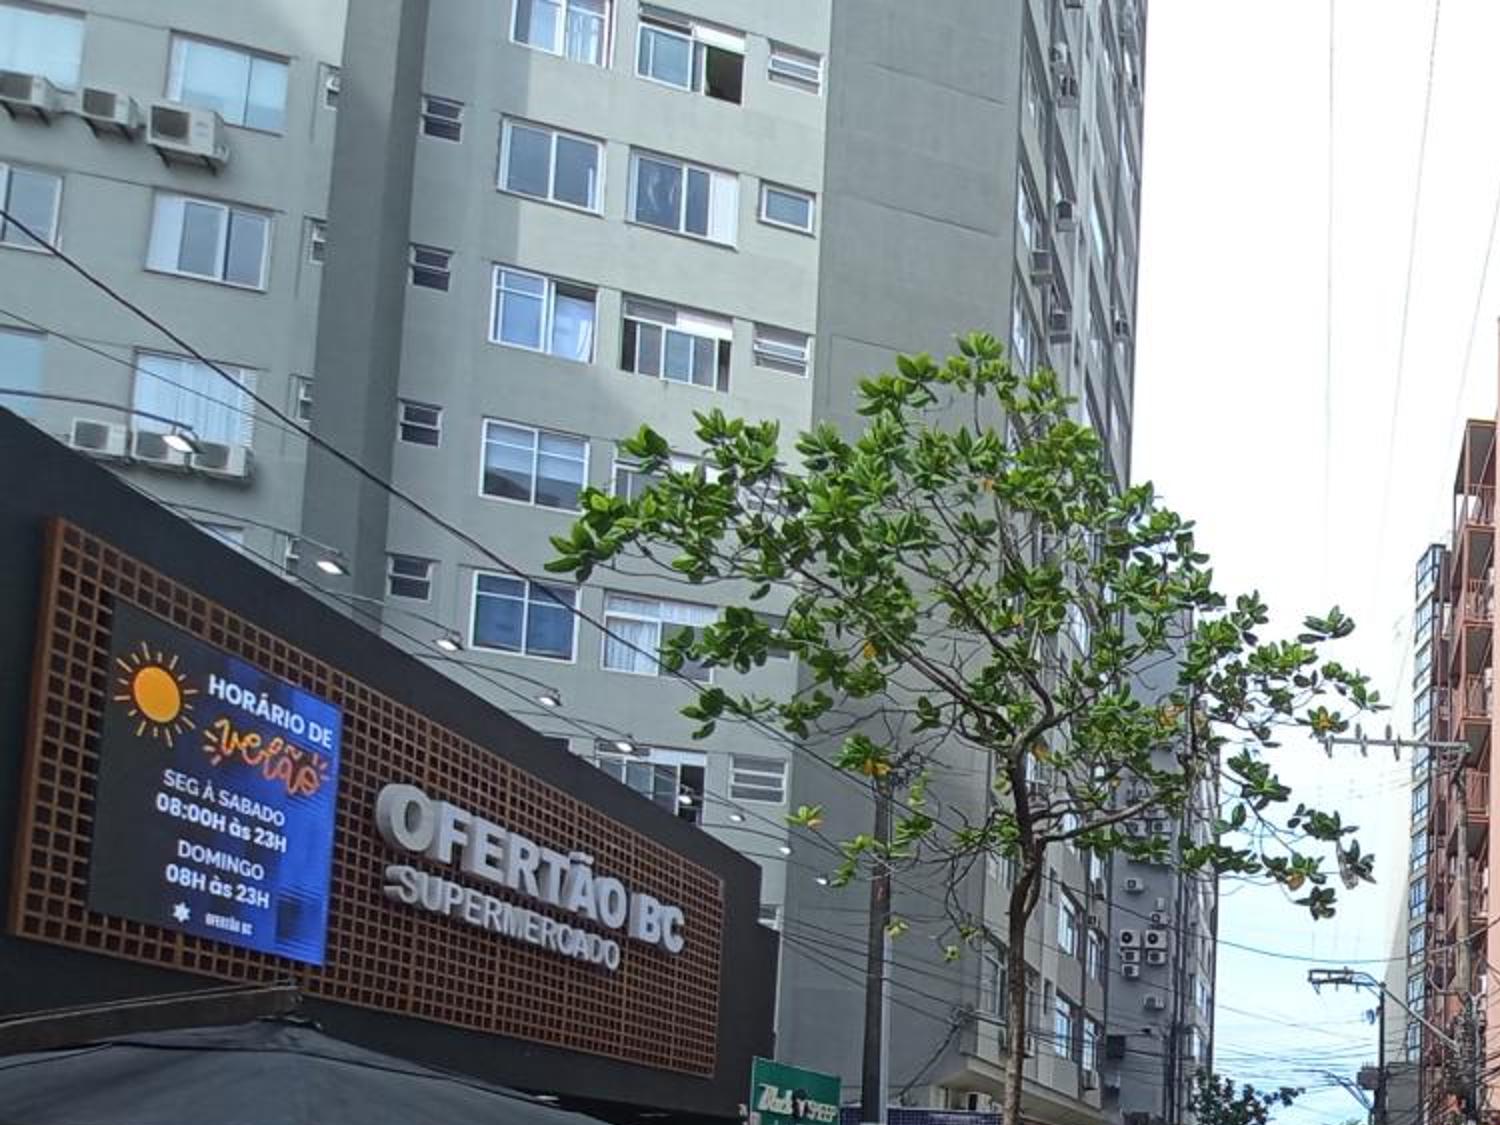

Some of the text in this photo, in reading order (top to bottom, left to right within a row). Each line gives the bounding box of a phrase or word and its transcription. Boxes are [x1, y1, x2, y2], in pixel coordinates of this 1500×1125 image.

[208, 674, 334, 749] HORÁRIO DE
[163, 768, 200, 796] SEG
[156, 792, 287, 853] 08:00H às 23H
[165, 863, 270, 909] 08H às 23H
[177, 839, 265, 881] DOMINGO
[376, 782, 686, 954] OFERTÃO BC
[384, 864, 621, 971] SUPERMERCADO
